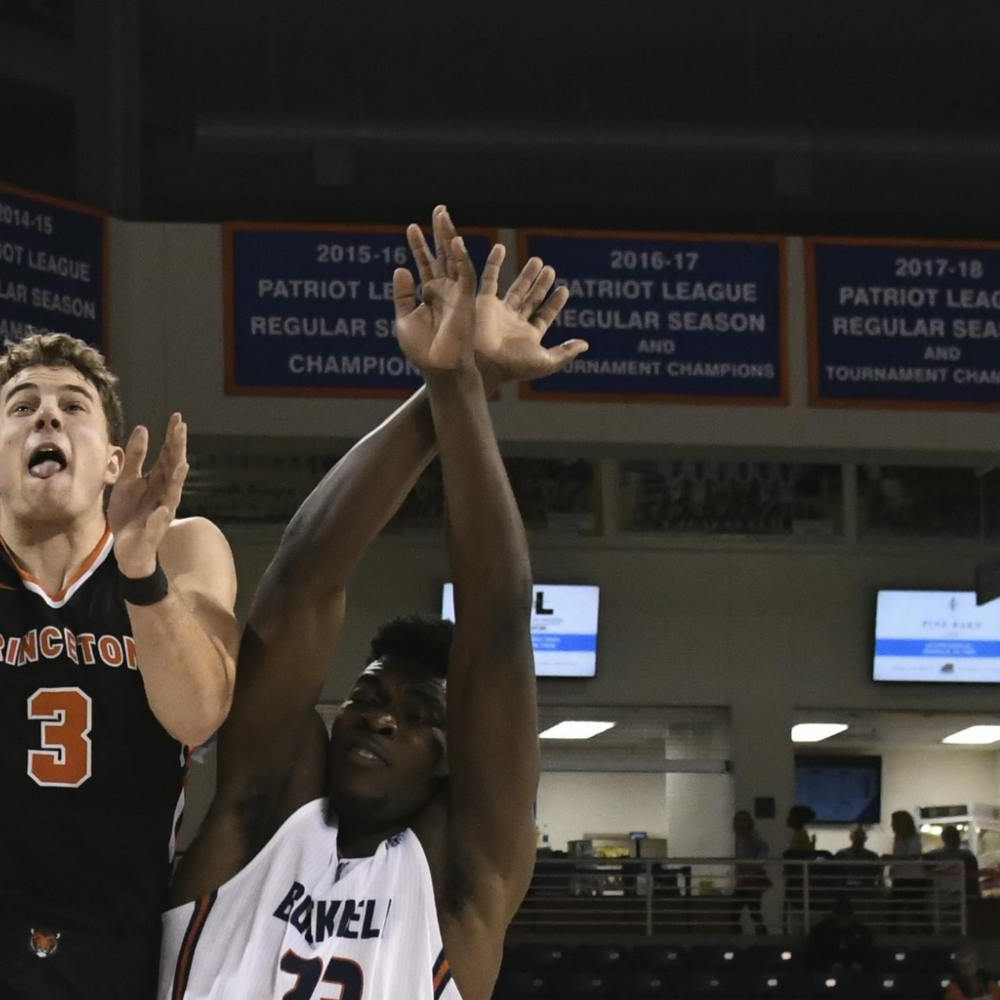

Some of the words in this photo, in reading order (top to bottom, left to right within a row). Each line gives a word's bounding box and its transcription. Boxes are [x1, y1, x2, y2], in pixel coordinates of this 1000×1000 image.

[316, 244, 408, 263] 2015-16
[609, 250, 699, 271] 2016-17
[28, 249, 92, 283] LEAGUE
[895, 257, 984, 279] 2017-18
[258, 279, 361, 299] PATRIOT
[661, 281, 758, 303] LEAGUE
[839, 286, 939, 307] PATRIOT
[31, 287, 97, 320] SEASON
[250, 316, 367, 337] REGULAR
[667, 312, 766, 333] SEASON
[832, 316, 945, 337] REGULAR
[952, 319, 1000, 339] SEA
[637, 339, 676, 354] AND
[924, 346, 961, 361] AND
[667, 362, 775, 379] CHAMPIONS
[825, 365, 949, 382] TOURNAMENT
[27, 686, 92, 788] 3
